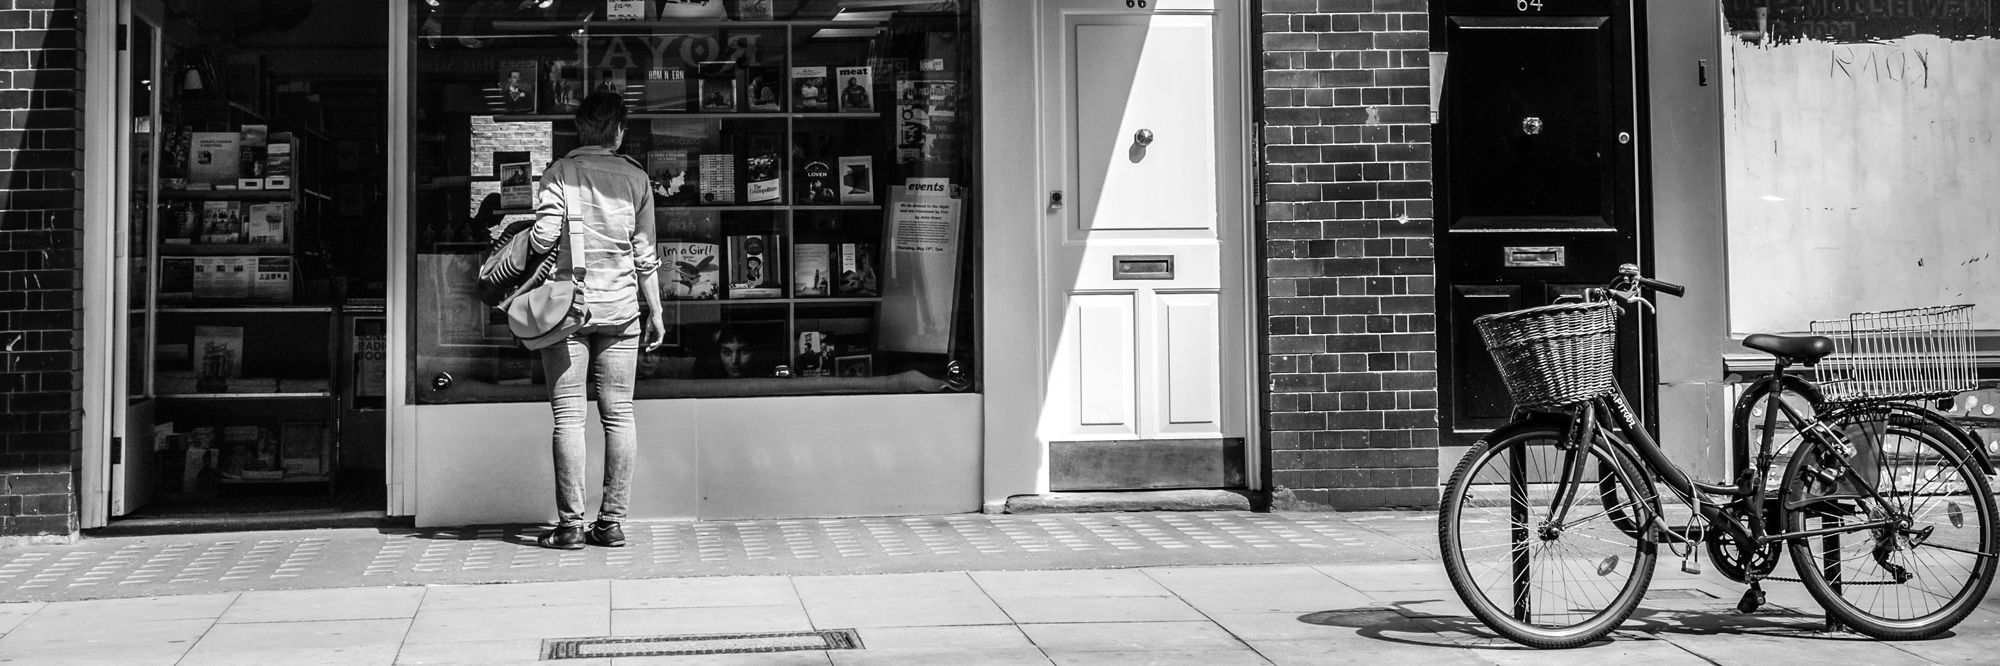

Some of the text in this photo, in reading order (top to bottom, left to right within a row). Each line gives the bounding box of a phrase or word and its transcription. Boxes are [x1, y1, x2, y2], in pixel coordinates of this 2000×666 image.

[1517, 0, 1543, 11] 64
[648, 70, 685, 80] HOMNERN
[839, 68, 868, 76] meat
[908, 182, 945, 191] events
[663, 246, 678, 257] I'm
[689, 244, 712, 255] Girl!
[358, 341, 386, 350] RADI
